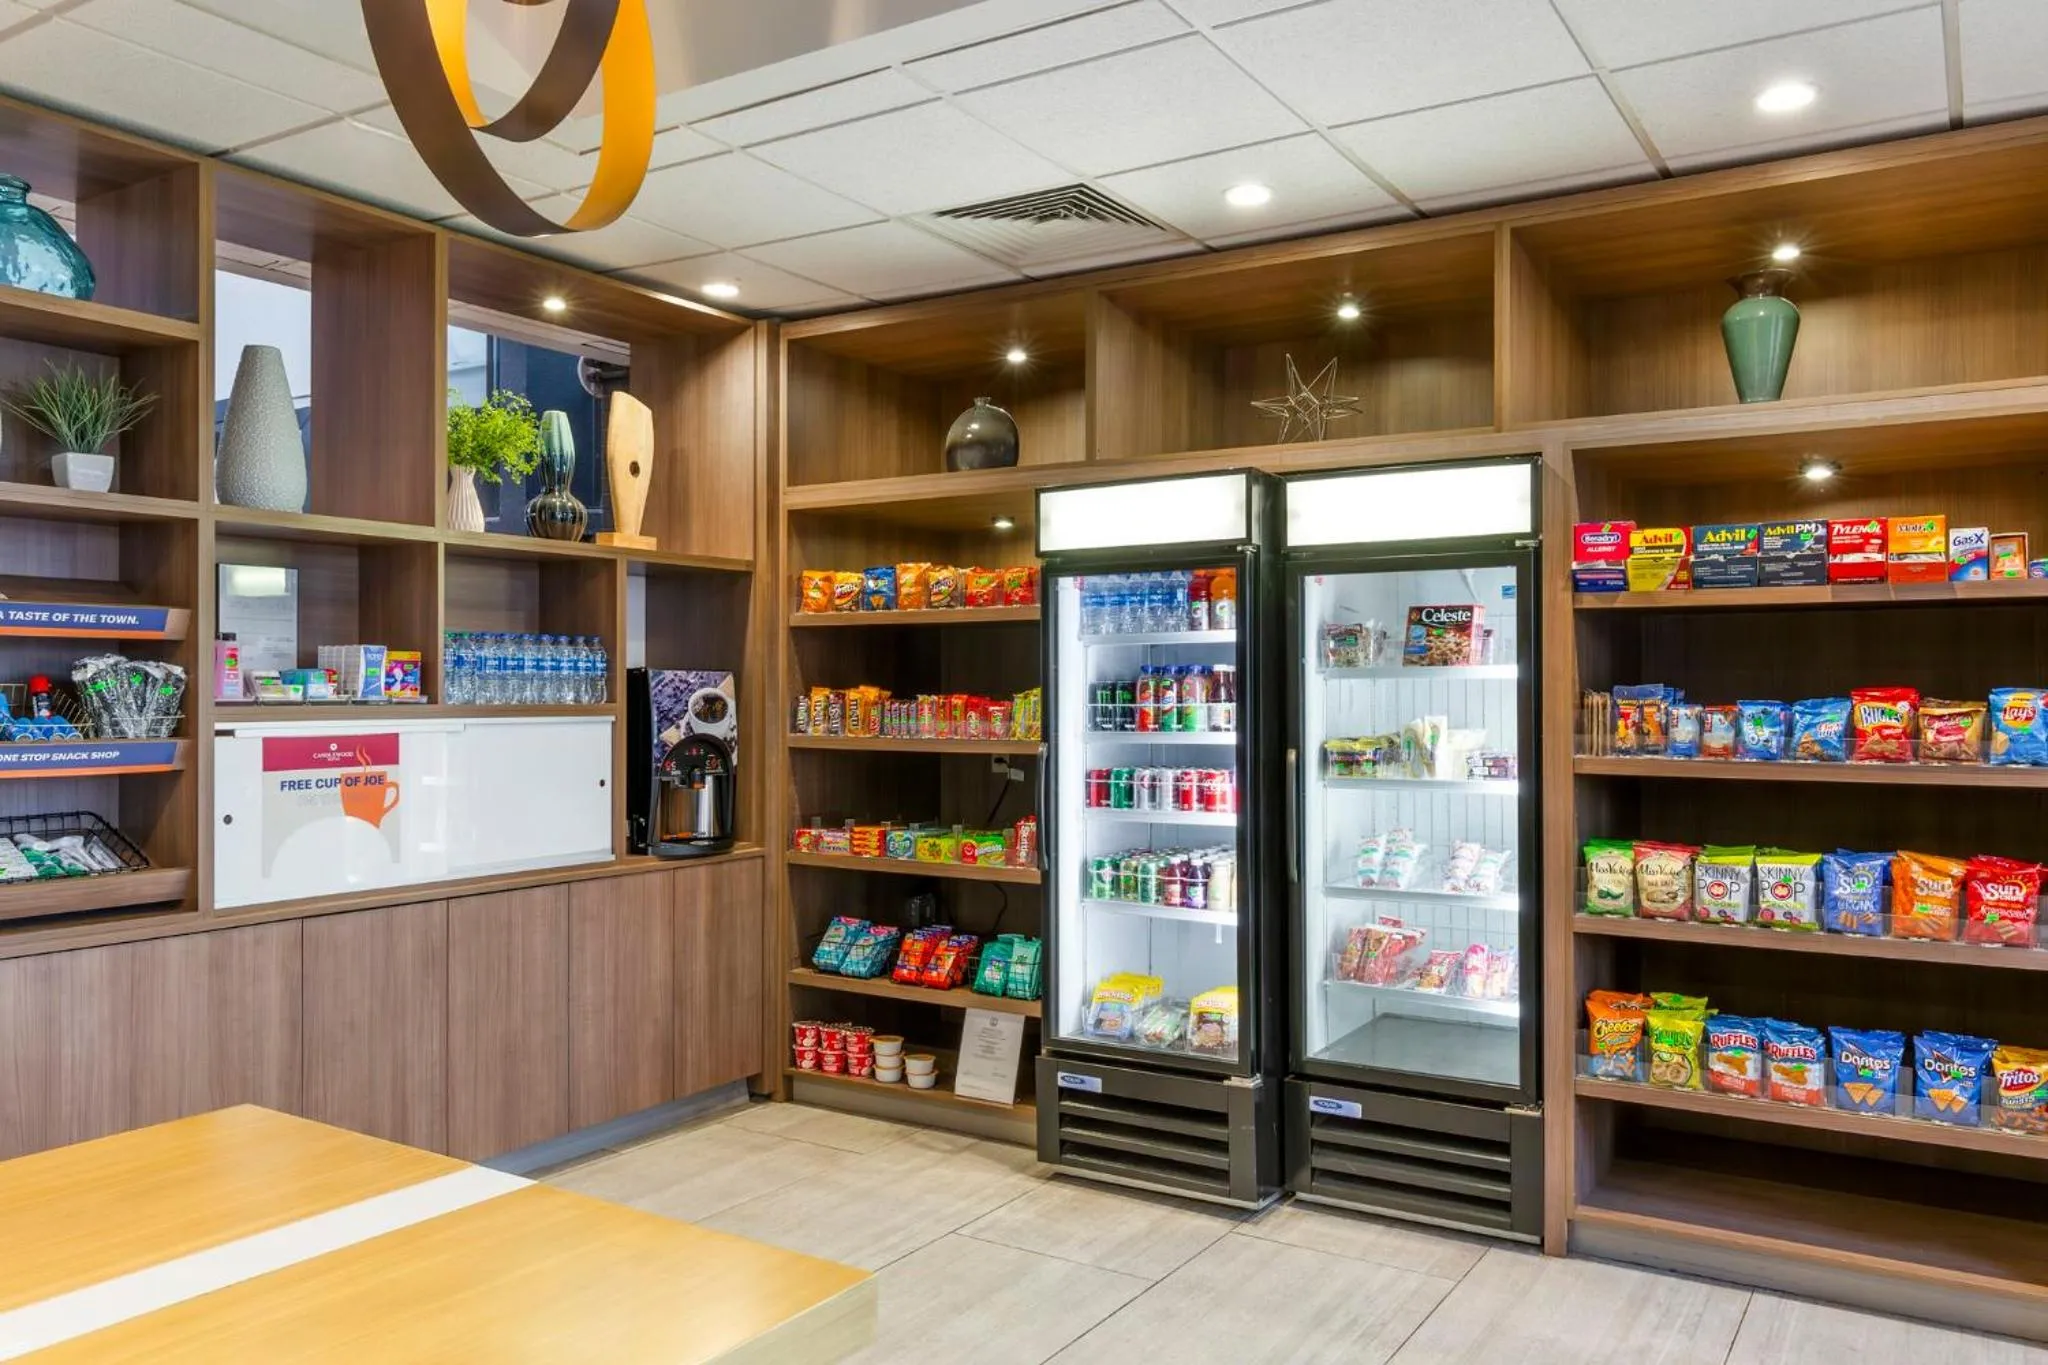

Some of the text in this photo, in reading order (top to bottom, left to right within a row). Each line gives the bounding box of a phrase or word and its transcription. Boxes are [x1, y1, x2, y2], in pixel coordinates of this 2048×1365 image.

[1703, 528, 1746, 543] Advil
[1764, 523, 1816, 536] Advil PM
[1831, 523, 1883, 536] TYLENOL
[1583, 534, 1618, 543] Benadryl
[1639, 532, 1674, 544] Advil
[8, 610, 49, 622] TASTE
[52, 612, 70, 622] OF
[72, 613, 98, 624] THE
[100, 614, 140, 625] TOWN.
[1421, 608, 1472, 623] Celeste
[20, 752, 51, 762] STOP
[51, 751, 90, 761] SNACK
[91, 751, 120, 760] SHOP
[280, 775, 385, 791] FREE CUP OF JOE
[1698, 866, 1740, 880] SKINNY
[1760, 866, 1806, 881] SKINNY
[1697, 878, 1741, 901] POP
[1760, 880, 1806, 902] POP
[1984, 882, 2021, 901] Sun
[1710, 1032, 1758, 1050] RUFFLES
[1770, 1044, 1817, 1060] RUFFLES
[1841, 1051, 1891, 1070] Doritos
[1924, 1058, 1977, 1078] Doritos
